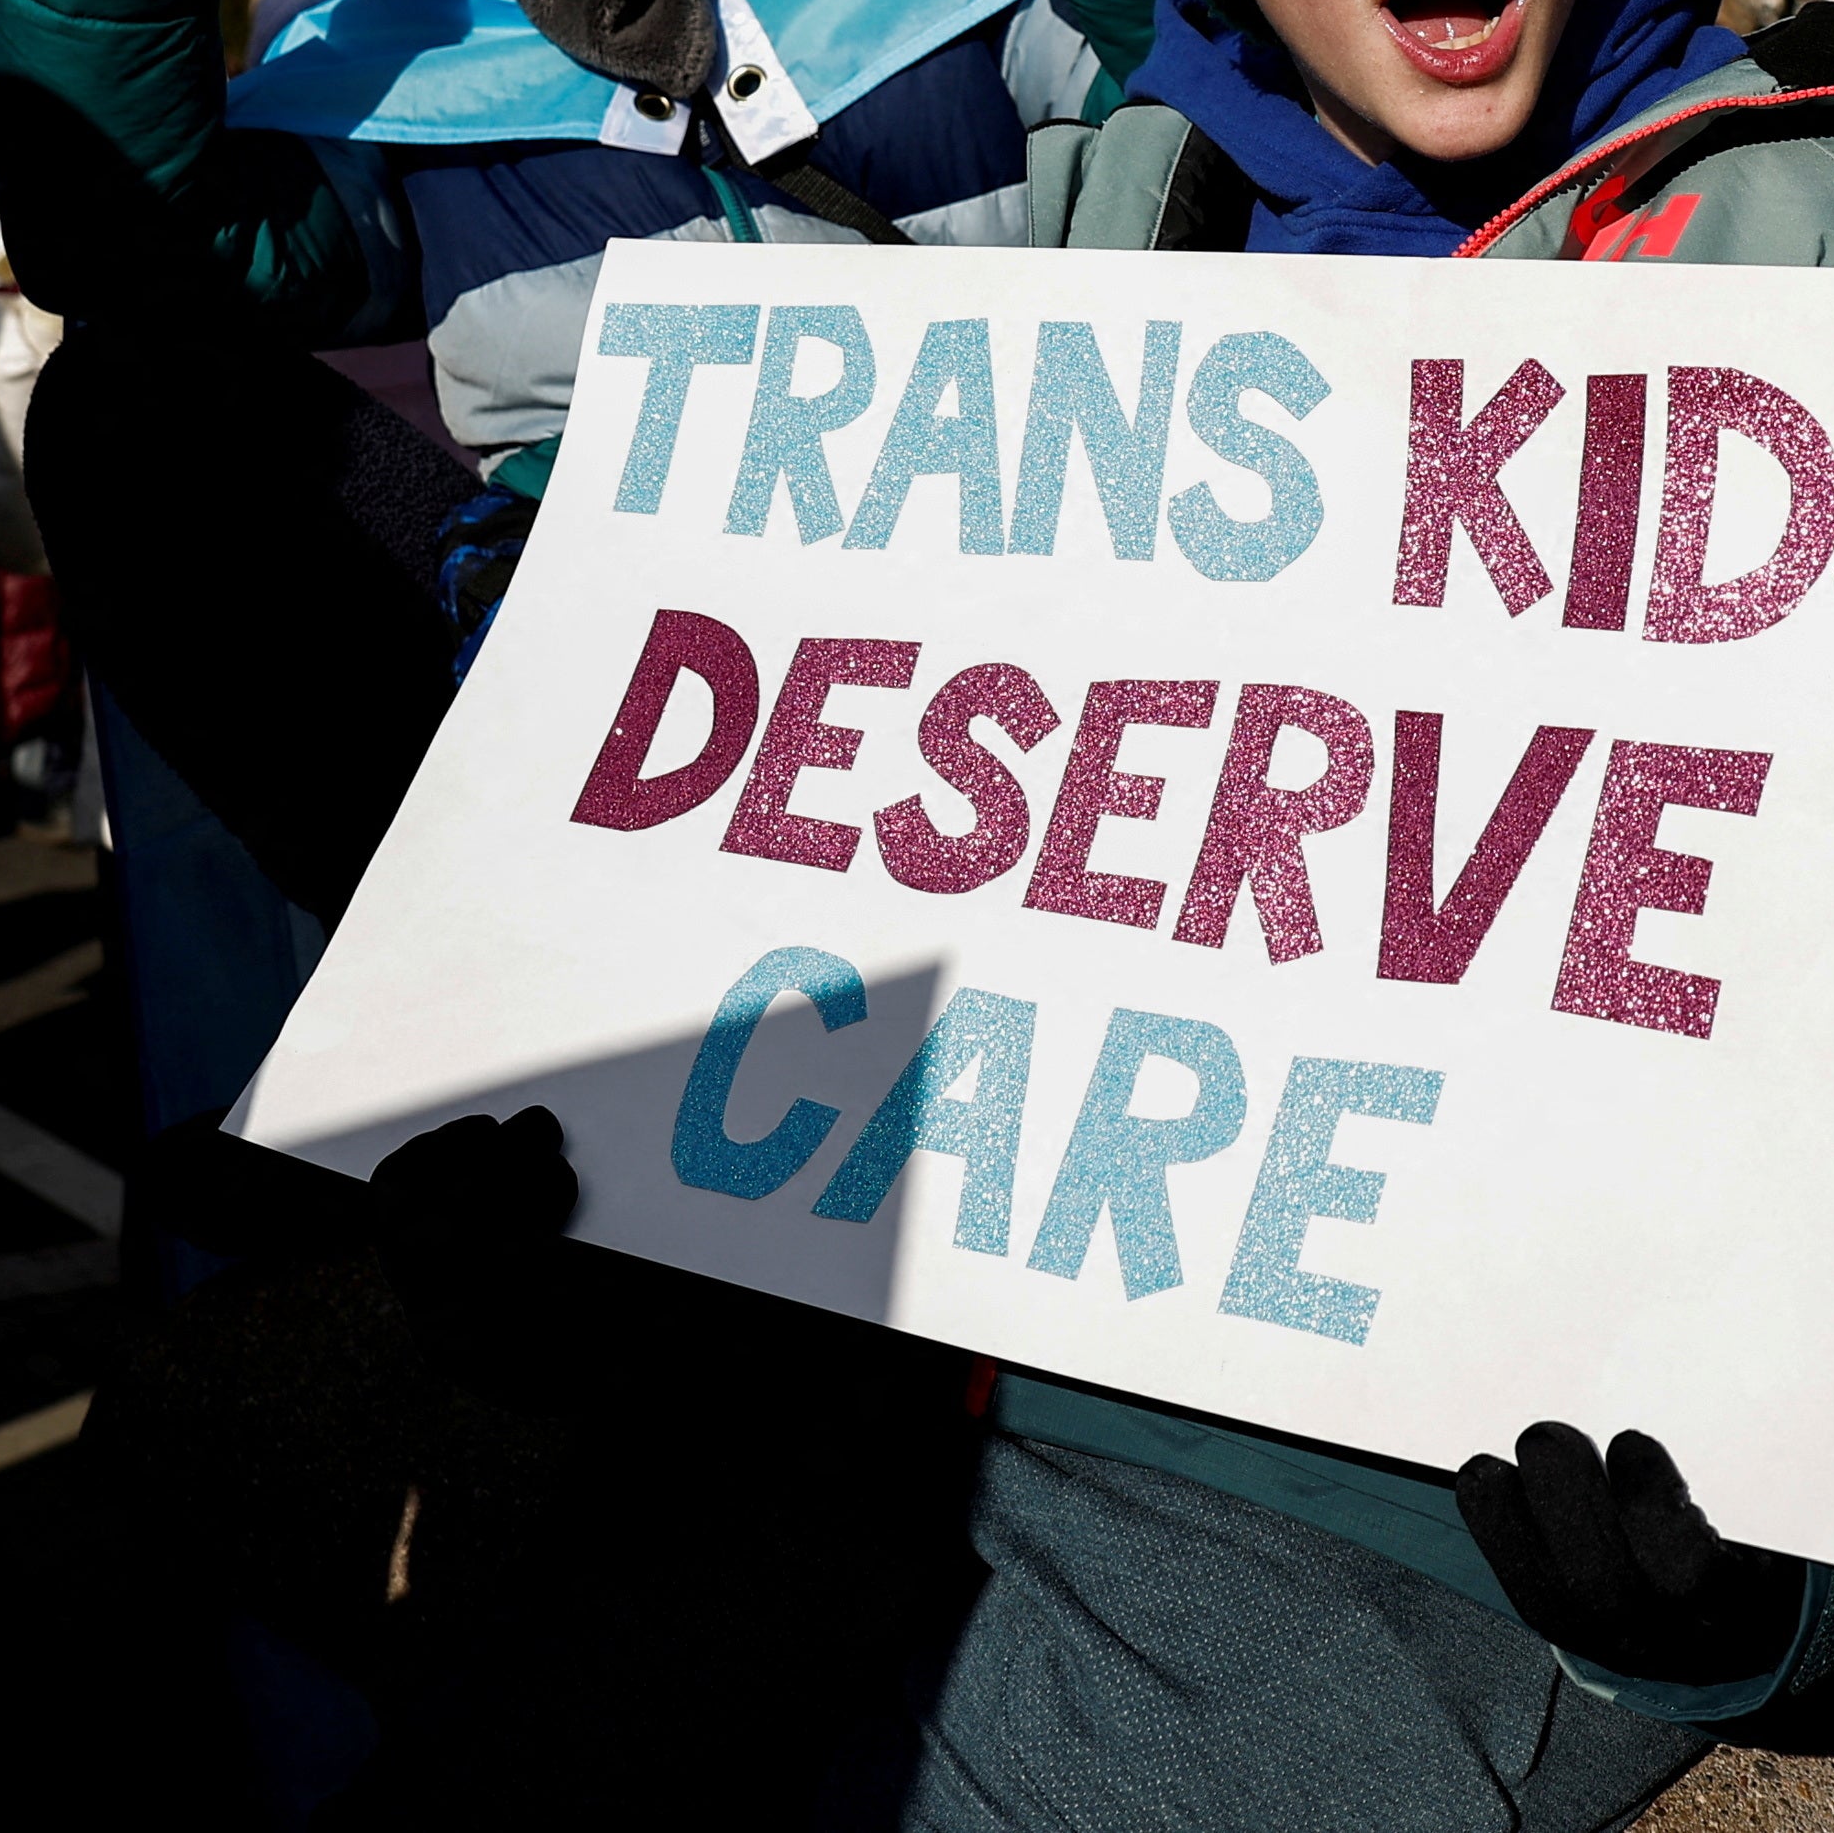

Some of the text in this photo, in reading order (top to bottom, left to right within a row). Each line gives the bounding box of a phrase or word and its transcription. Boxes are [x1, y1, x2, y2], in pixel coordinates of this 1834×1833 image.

[597, 302, 1332, 582] TRANS
[569, 607, 1773, 1040] DESERVE
[670, 946, 1446, 1346] CARE
